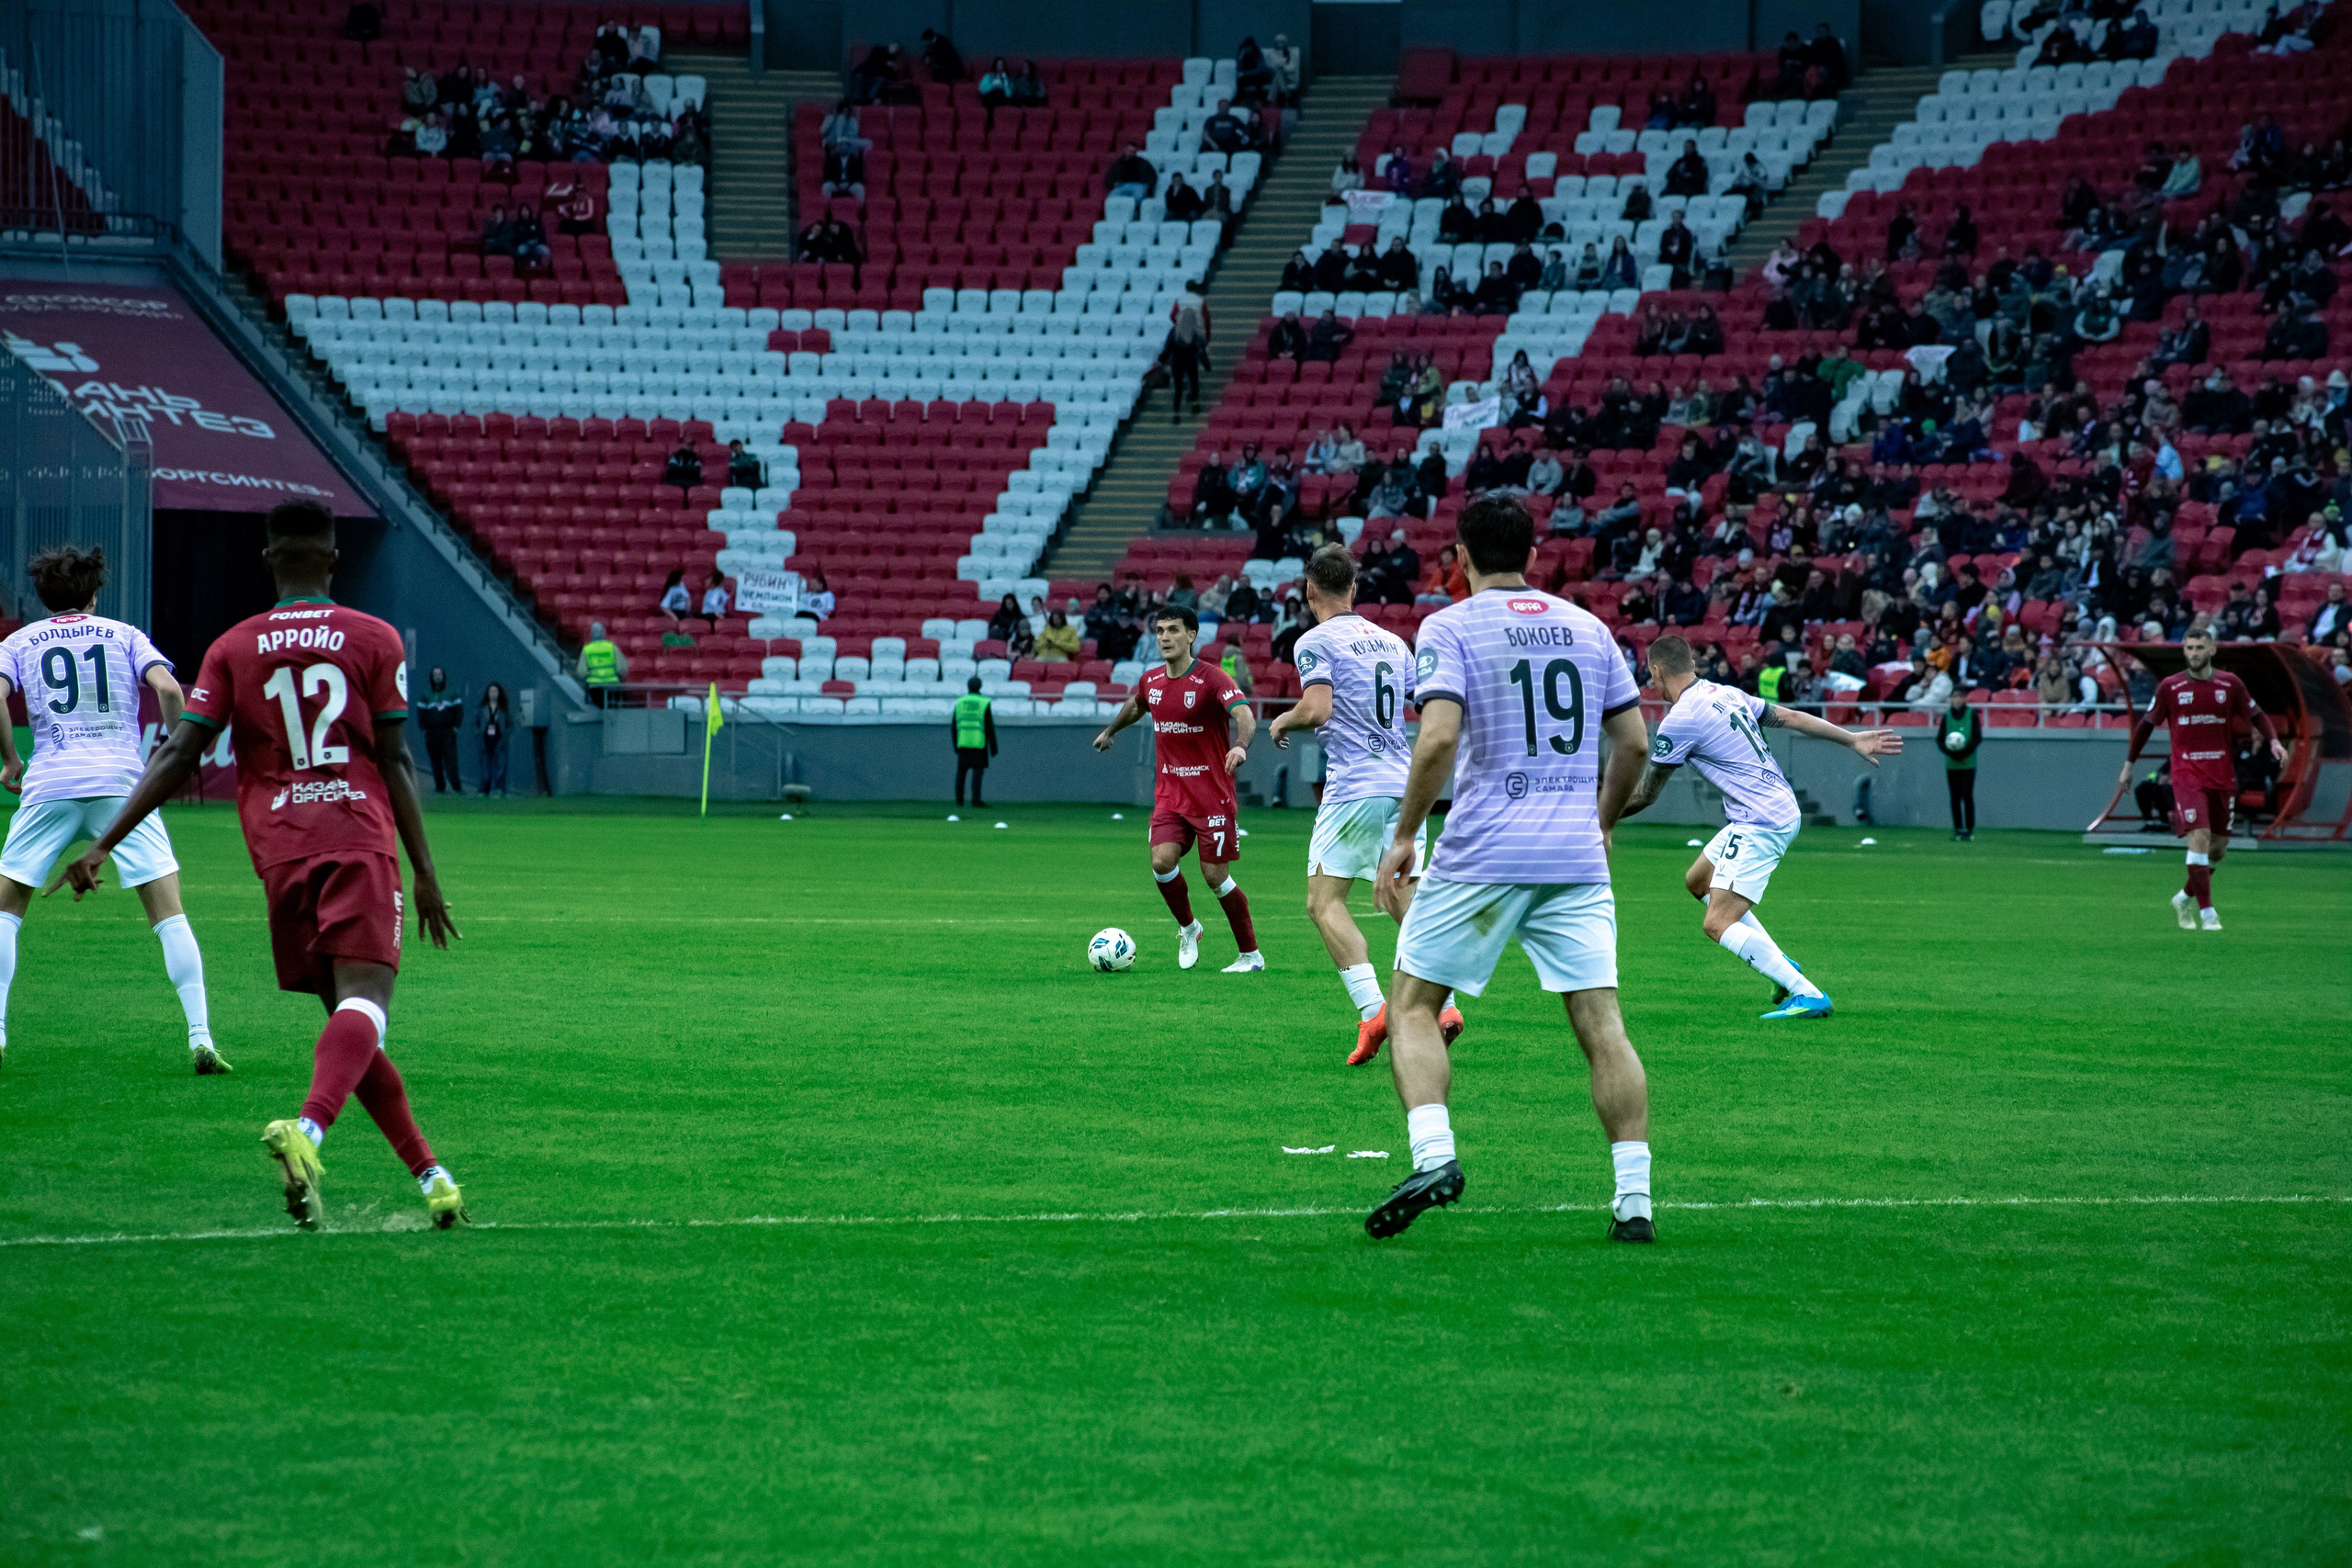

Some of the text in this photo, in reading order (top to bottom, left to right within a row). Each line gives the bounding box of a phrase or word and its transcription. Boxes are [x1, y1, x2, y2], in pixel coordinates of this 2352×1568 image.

[268, 609, 334, 621] FONBET
[28, 625, 115, 647] БОЛДЫРЕВ
[257, 625, 345, 655] АРРОЙО
[1504, 626, 1574, 647] БОКОЕВ
[1350, 639, 1399, 657] КУЗЬМИН
[41, 643, 110, 715] 91
[1148, 687, 1164, 697] FON
[1148, 696, 1162, 705] BET
[1374, 661, 1396, 730] 6
[263, 662, 350, 772] 12
[1509, 658, 1586, 758] 19
[1535, 785, 1576, 794] САМАРА
[1208, 818, 1227, 828] BET
[1213, 830, 1226, 857] 7
